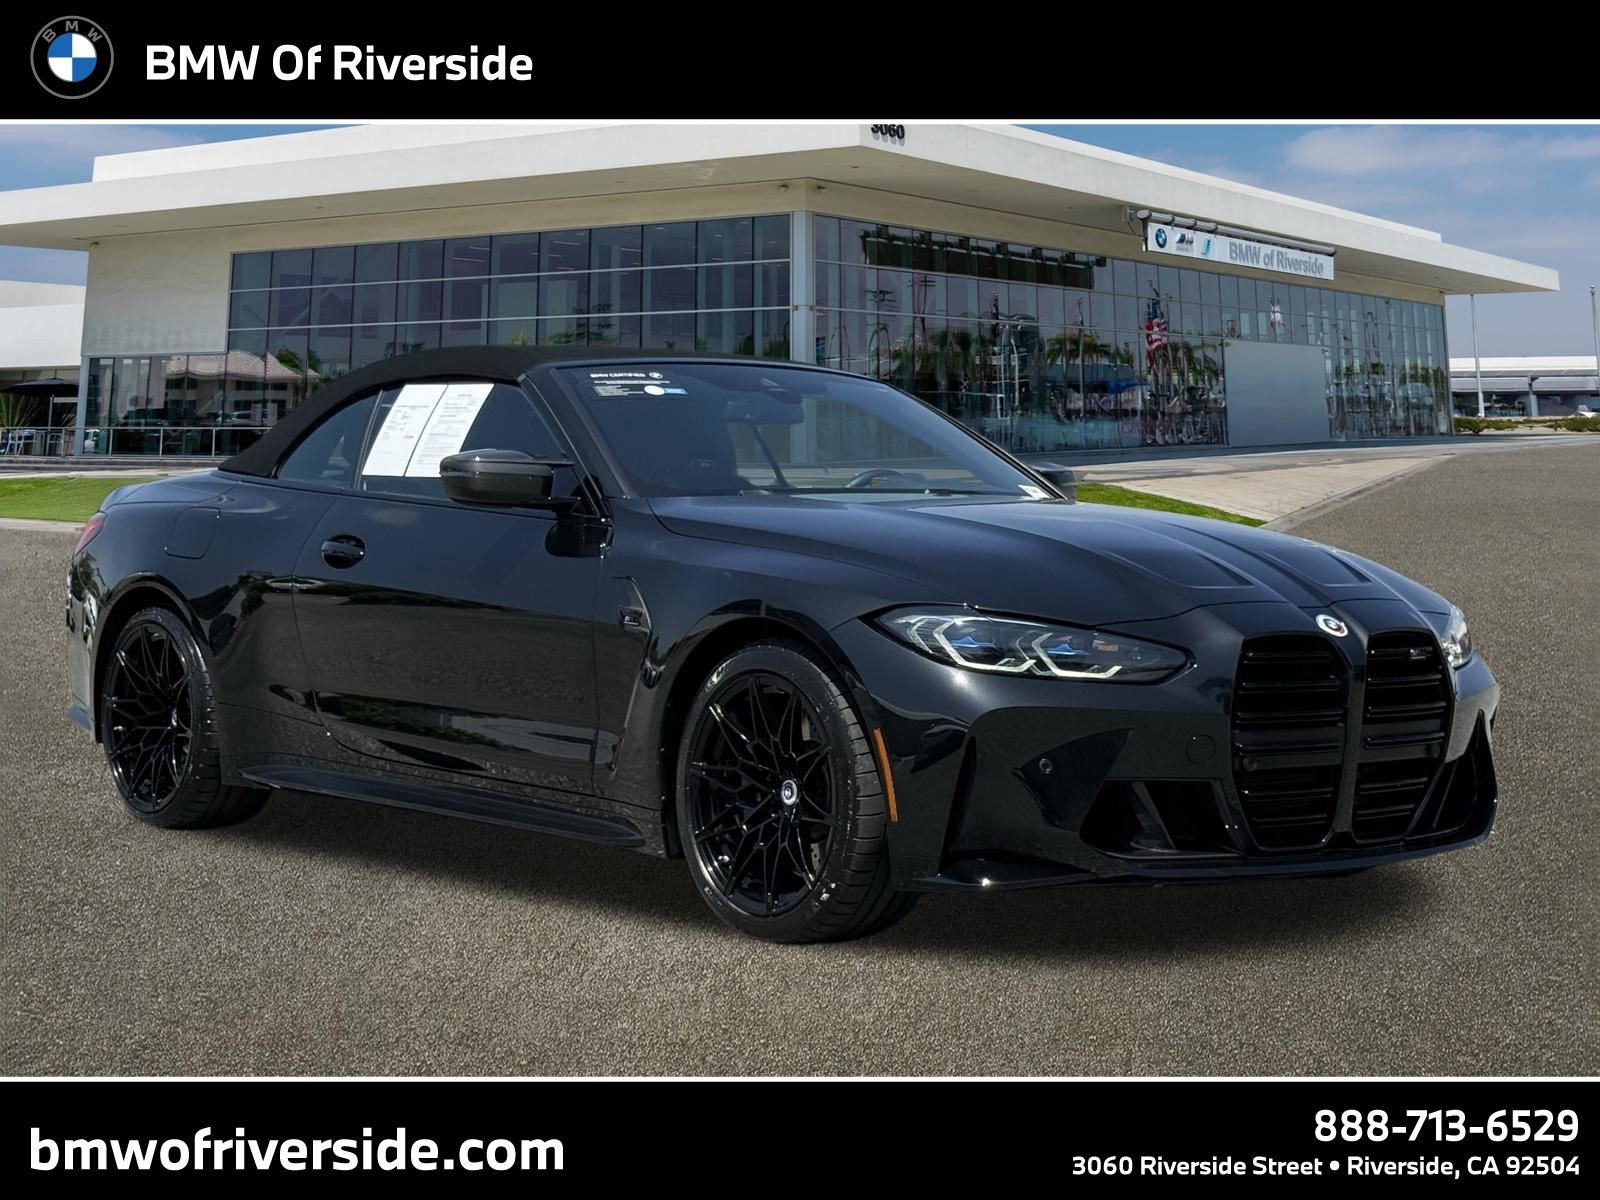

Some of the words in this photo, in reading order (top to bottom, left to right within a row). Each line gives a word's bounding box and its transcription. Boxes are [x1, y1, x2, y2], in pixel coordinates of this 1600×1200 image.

[1229, 241, 1261, 266] BMW
[1263, 249, 1275, 267] of
[1276, 250, 1324, 275] Riverside
